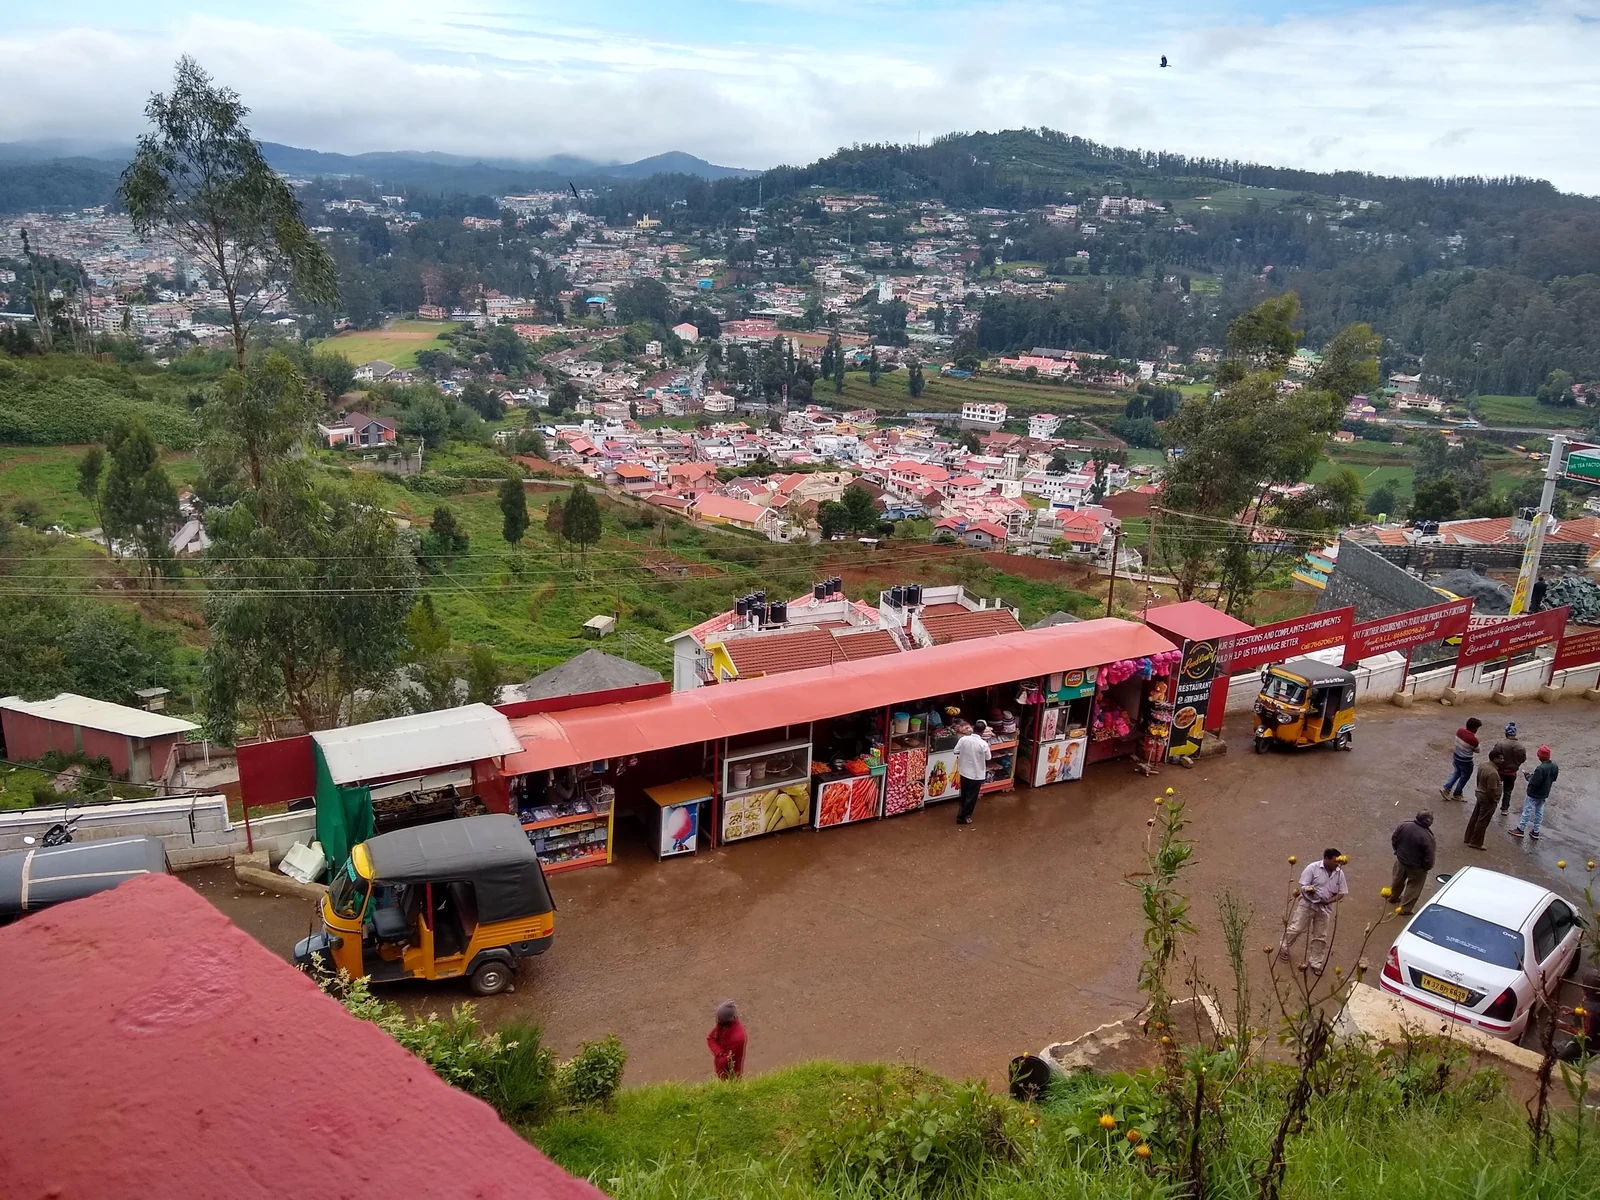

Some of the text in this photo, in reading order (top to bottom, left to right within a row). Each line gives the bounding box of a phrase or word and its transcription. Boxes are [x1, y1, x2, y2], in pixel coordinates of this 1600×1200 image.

[1264, 630, 1274, 640] AND
[1274, 624, 1305, 638] COMPLAINTS
[1308, 616, 1341, 630] COMPLIMENTS
[1509, 630, 1544, 644] BENCHMARK
[1251, 646, 1258, 656] TO
[1258, 642, 1280, 654] MANAGE
[1280, 638, 1299, 650] BETTER
[1178, 680, 1212, 692] RESTAURANT
[1423, 978, 1431, 986] TN
